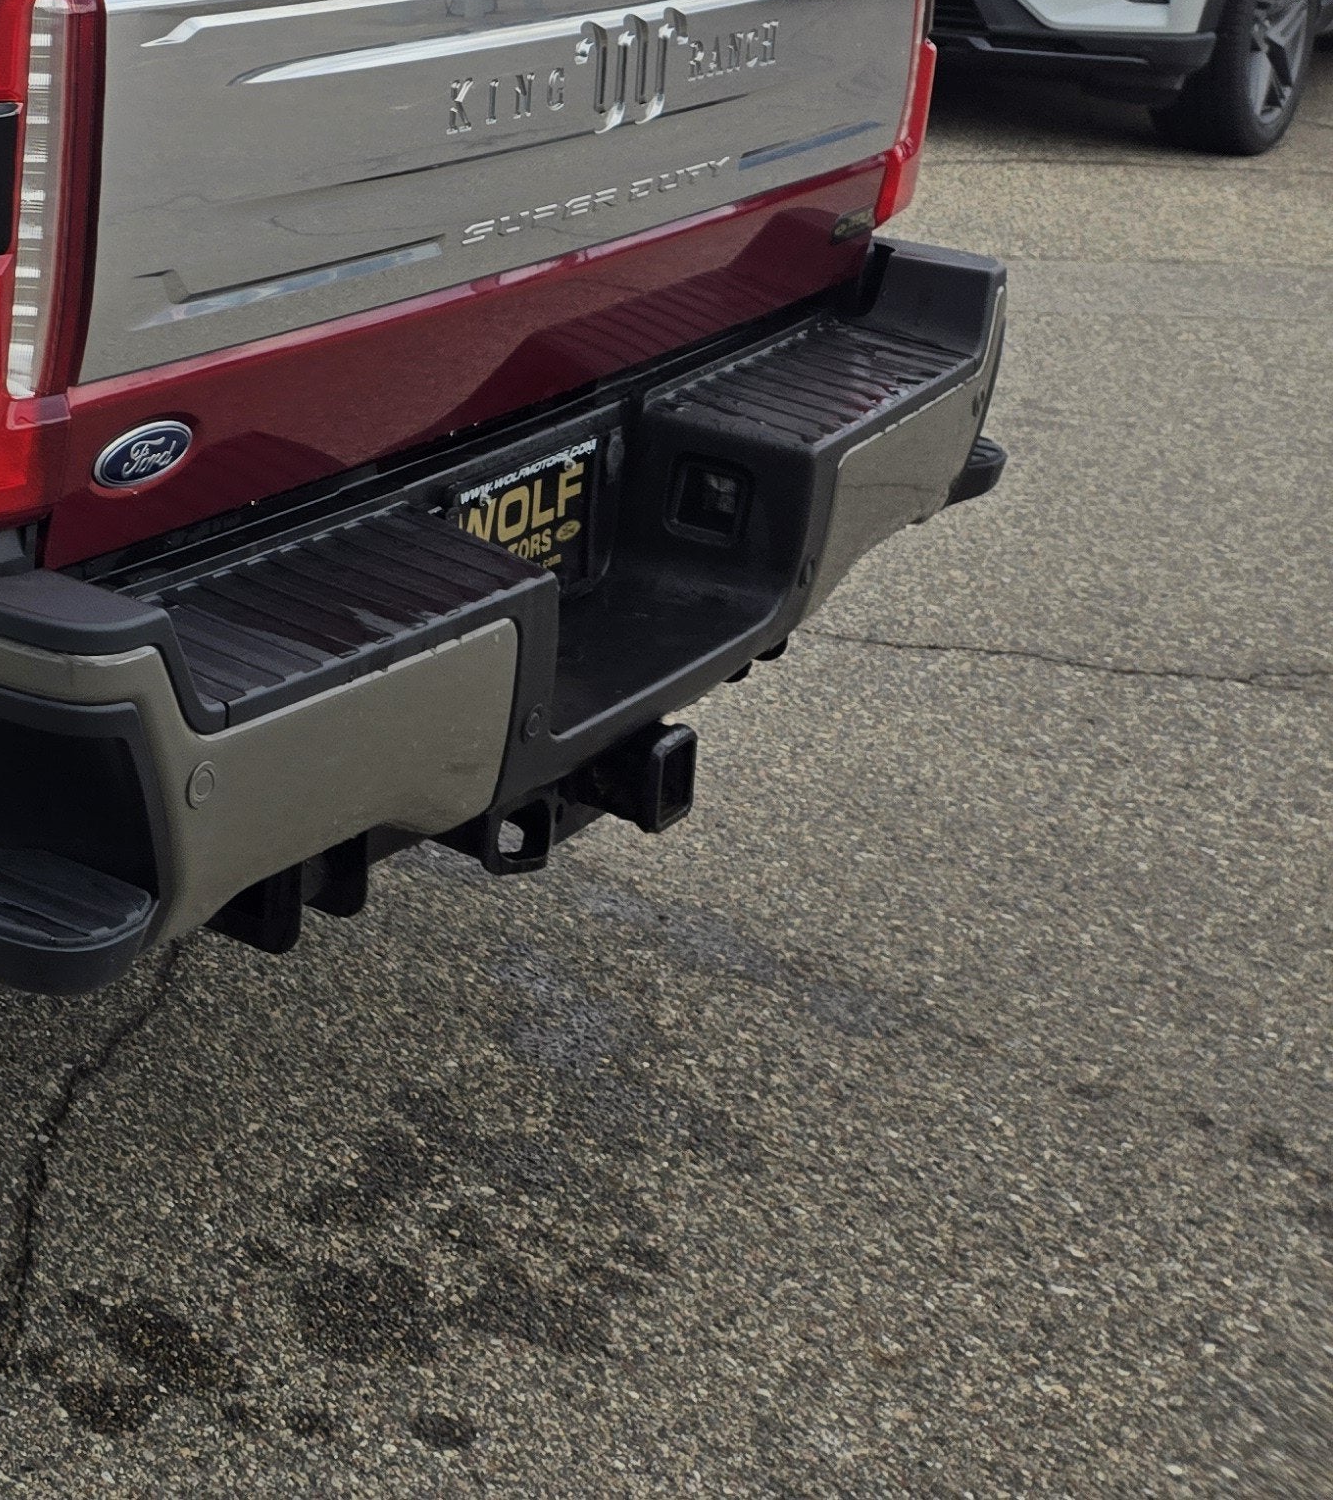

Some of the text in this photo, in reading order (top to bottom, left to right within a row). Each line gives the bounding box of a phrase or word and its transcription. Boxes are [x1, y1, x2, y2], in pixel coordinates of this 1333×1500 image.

[446, 19, 779, 135] KING RANCH
[462, 156, 730, 245] SUPER DUTY
[121, 436, 177, 479] Ford
[458, 461, 584, 543] WOLF
